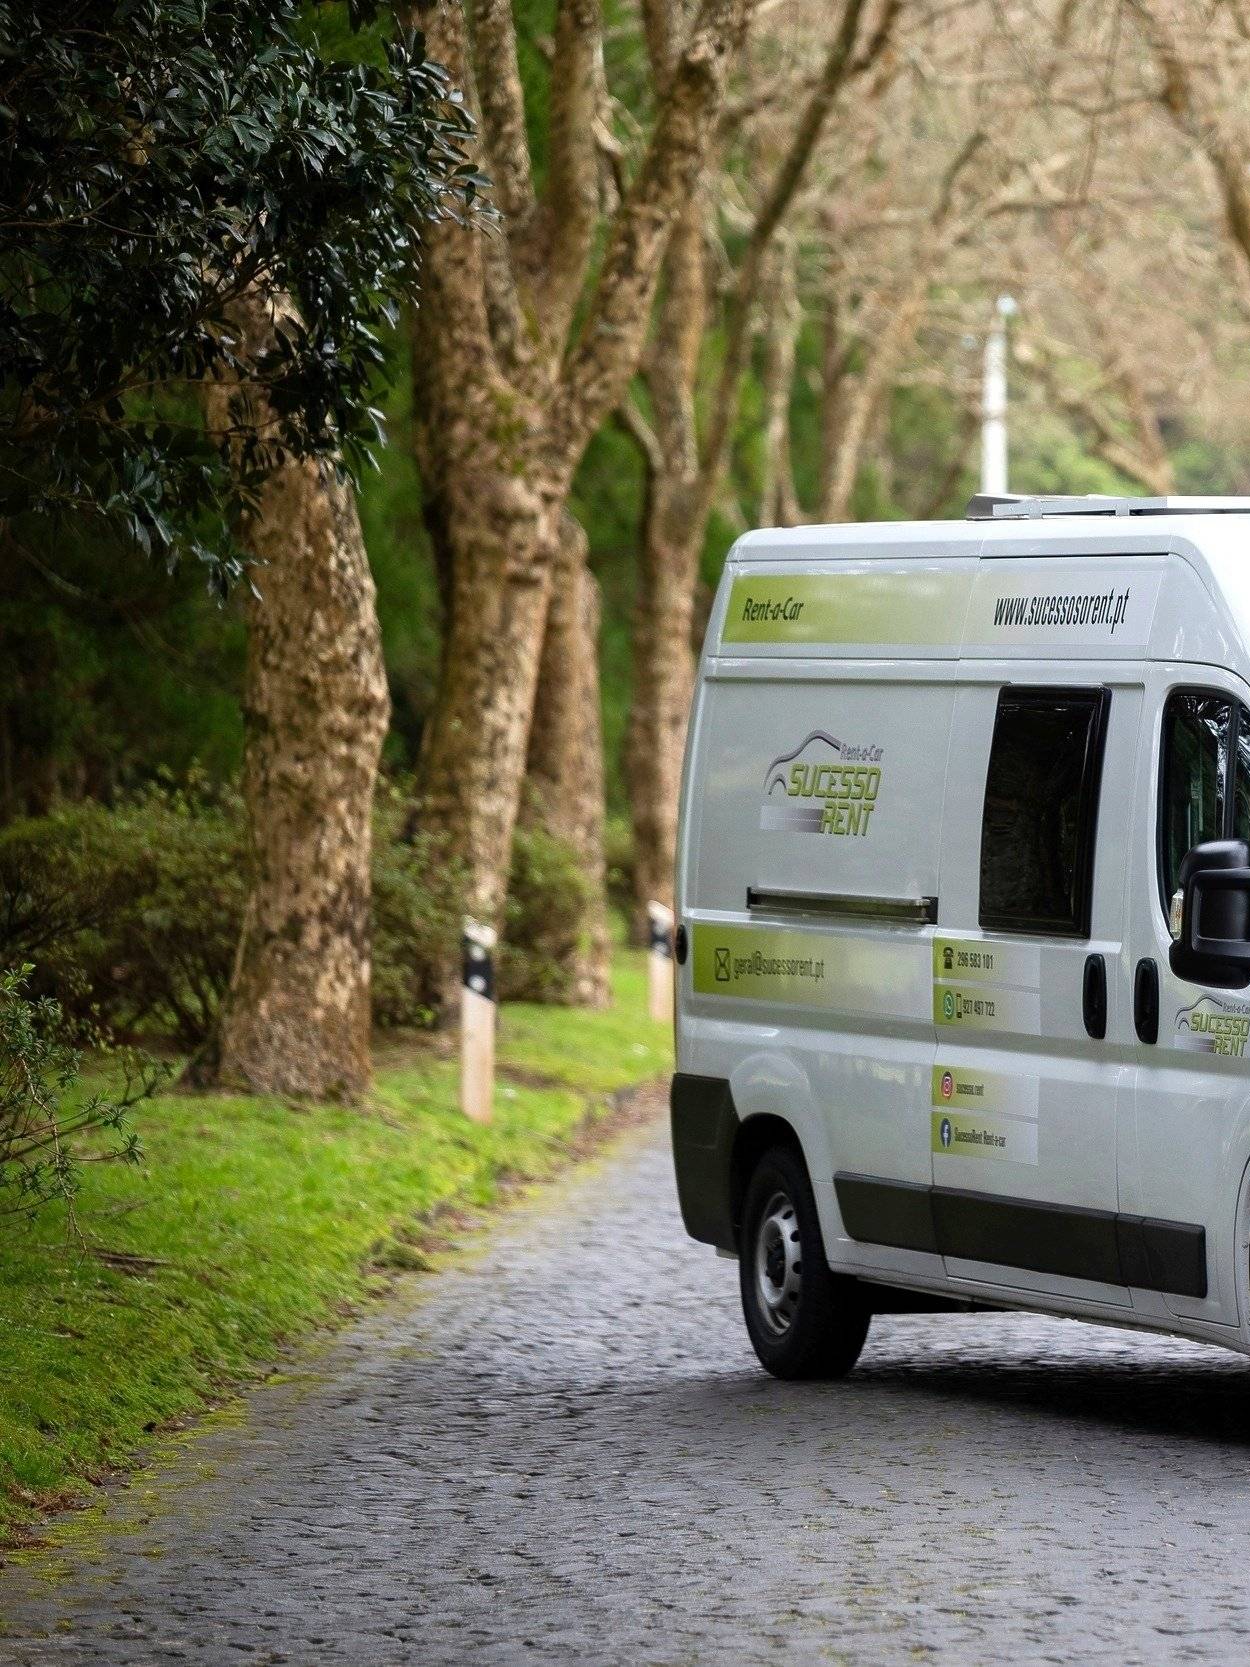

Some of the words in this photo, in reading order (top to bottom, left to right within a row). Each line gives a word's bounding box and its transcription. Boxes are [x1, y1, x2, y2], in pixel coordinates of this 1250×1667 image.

[742, 596, 804, 621] Rent-a-Car
[787, 763, 881, 801] SUCESSO
[819, 801, 874, 836] RENT
[1190, 1012, 1250, 1037] SUCESSO
[1213, 1034, 1248, 1057] RENT
